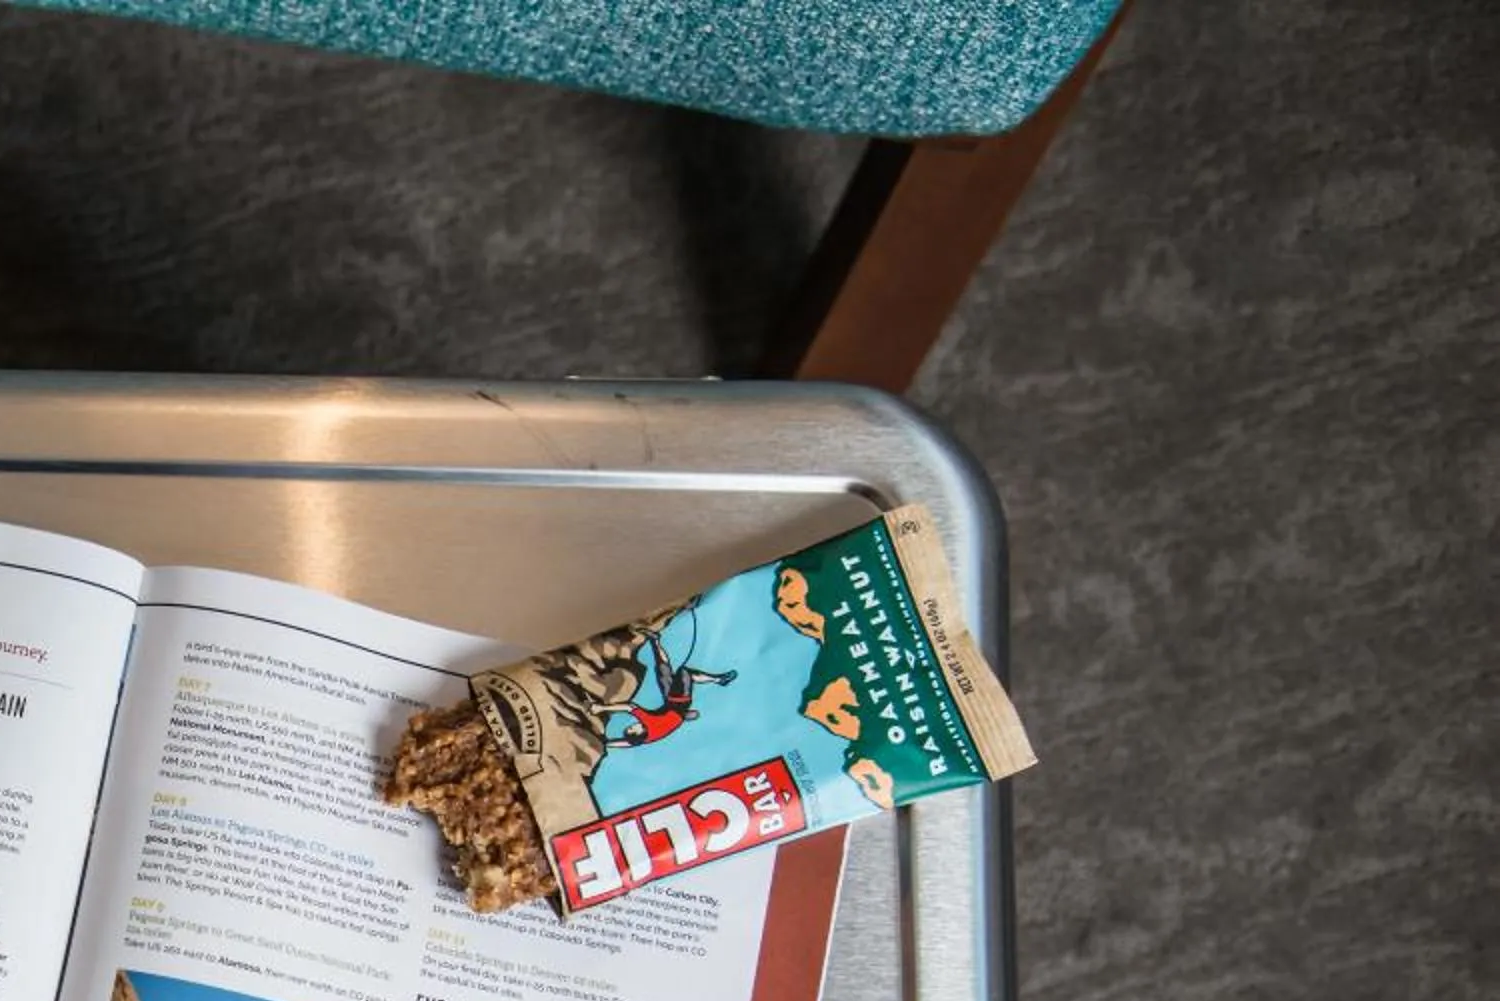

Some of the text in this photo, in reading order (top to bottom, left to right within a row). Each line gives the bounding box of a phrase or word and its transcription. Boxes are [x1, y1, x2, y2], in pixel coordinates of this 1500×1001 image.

[896, 593, 928, 667] SUSTAINED
[933, 626, 948, 643] OZ
[832, 601, 905, 744] OATMEAL
[841, 555, 948, 776] RAISIN WALNUT
[949, 659, 964, 677] WT
[928, 671, 943, 697] FOR
[957, 676, 974, 696] NET
[169, 714, 211, 733] National
[518, 704, 537, 748] OLLED
[939, 701, 978, 773] NUTRITION
[237, 770, 256, 781] Los
[570, 788, 750, 900] CLIF
[745, 772, 787, 832] BAR
[539, 927, 583, 947] Colorado
